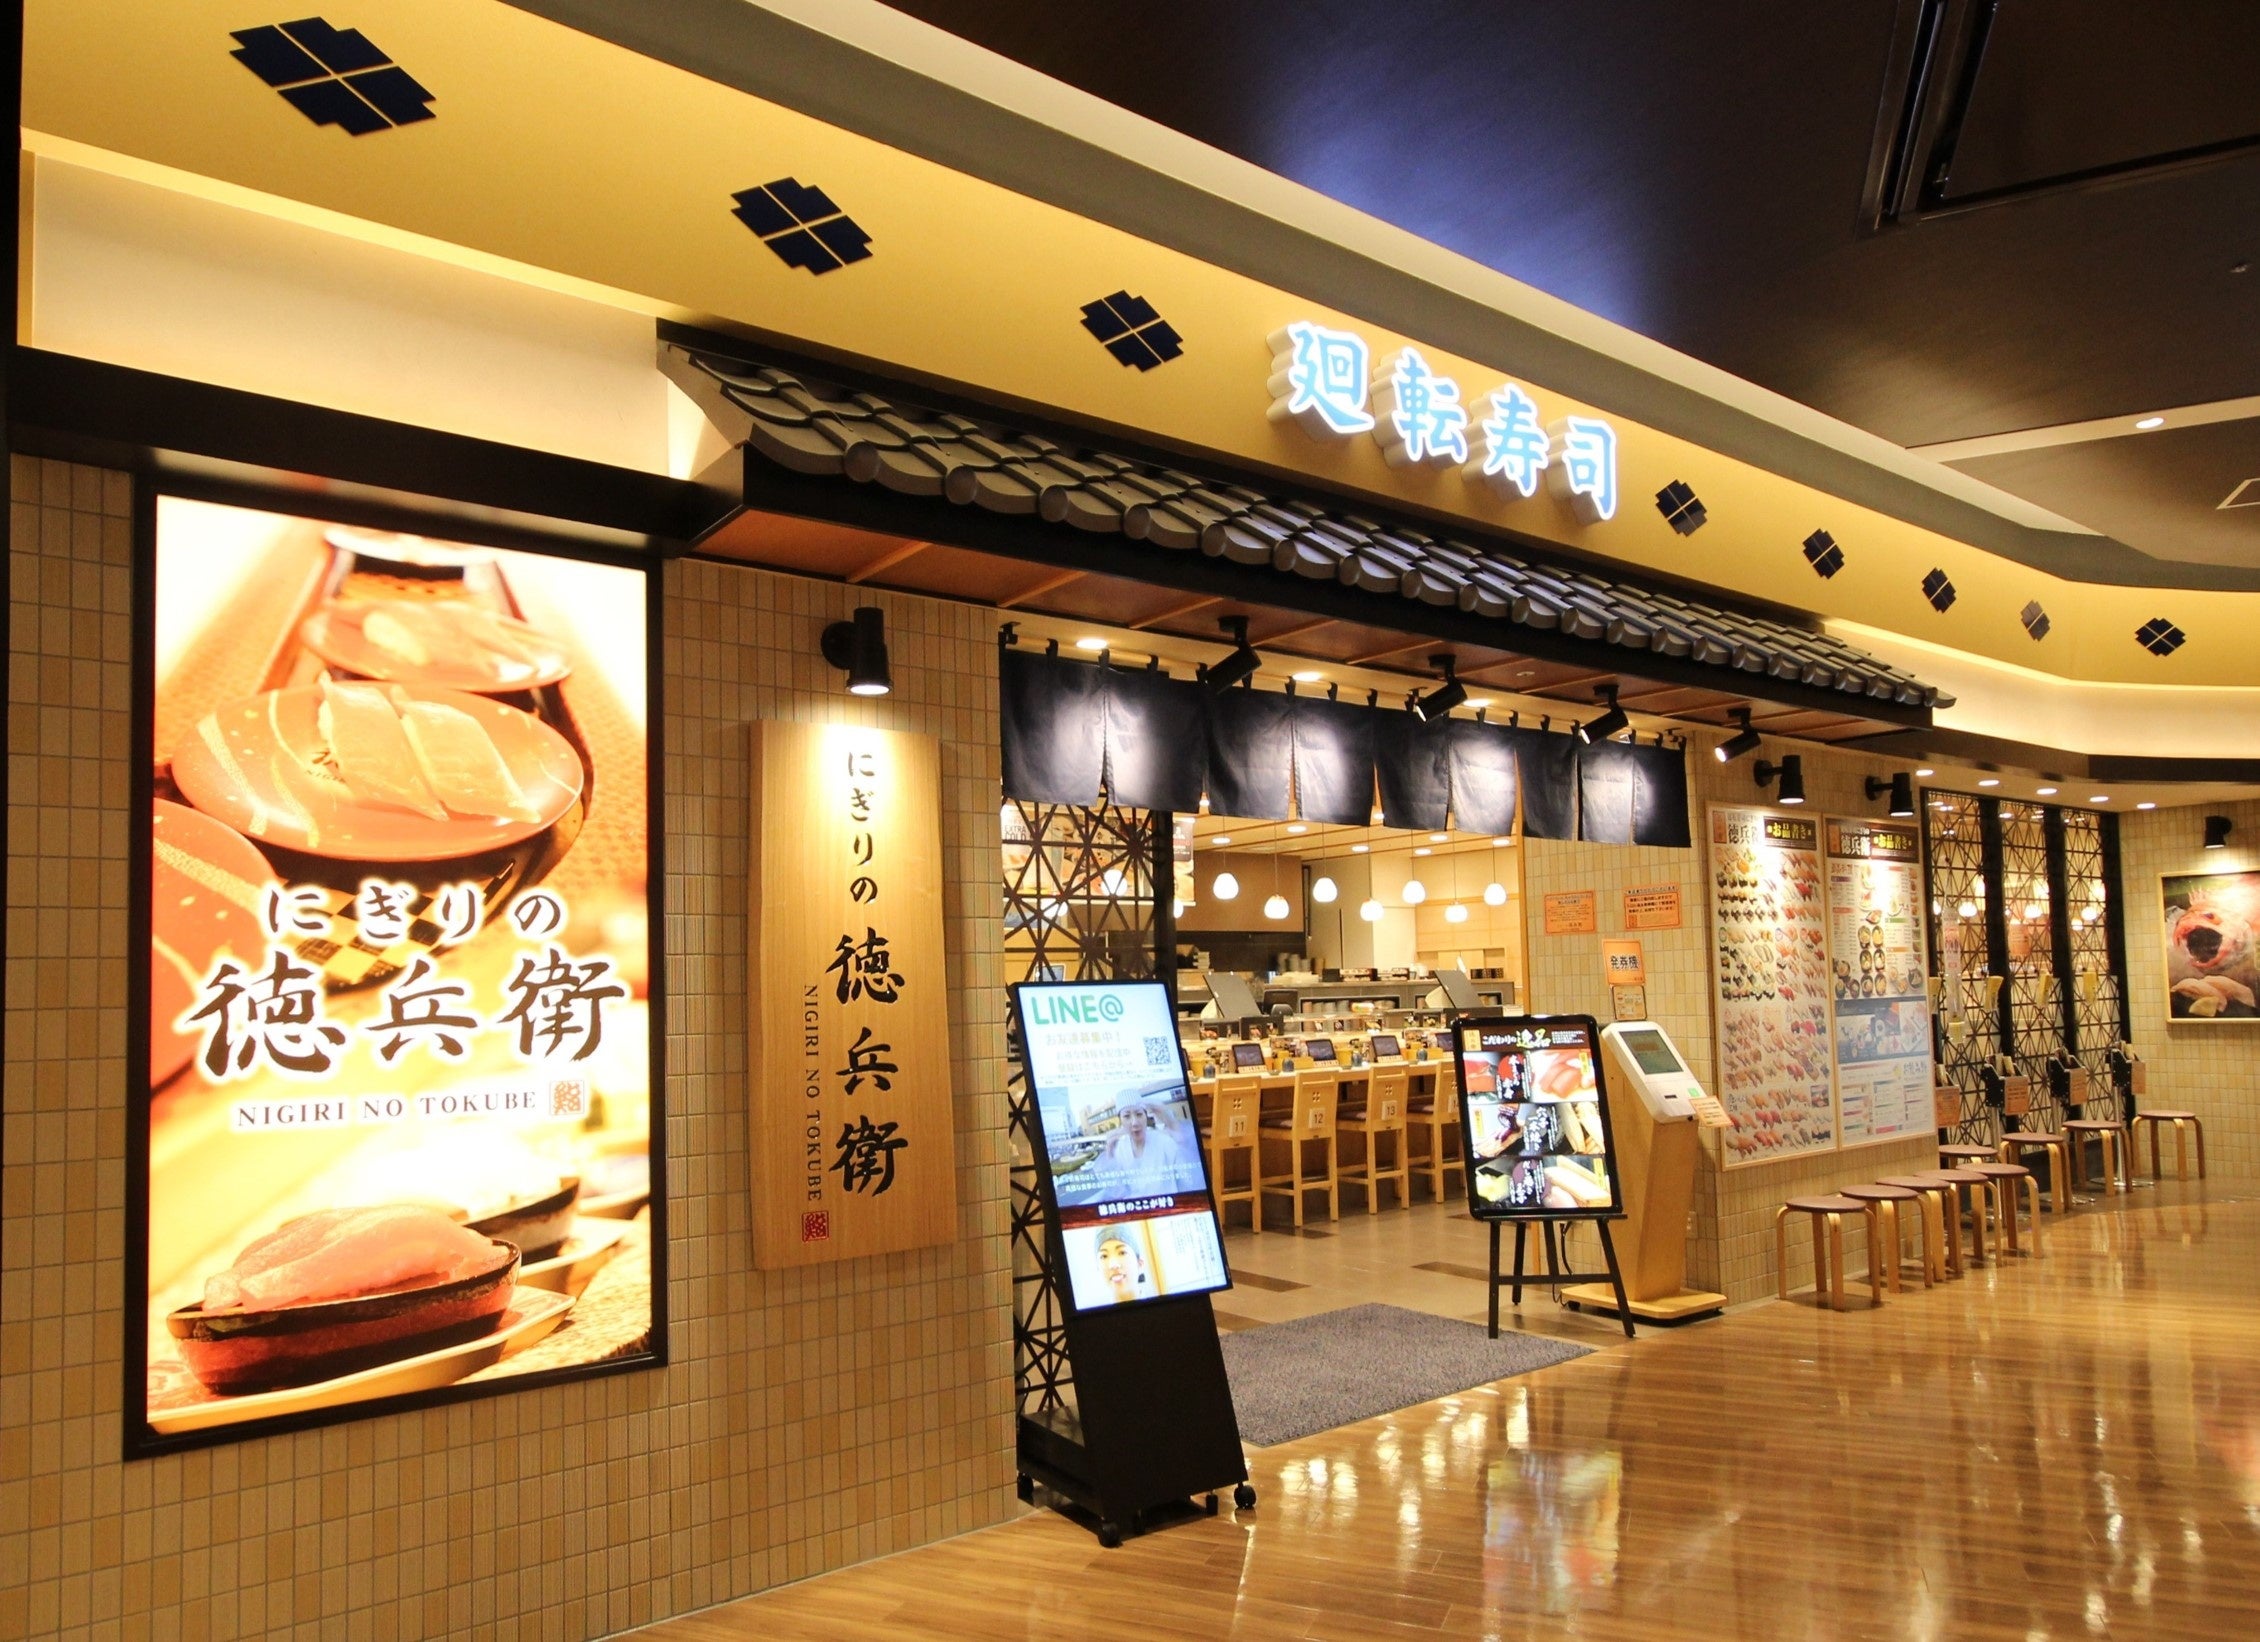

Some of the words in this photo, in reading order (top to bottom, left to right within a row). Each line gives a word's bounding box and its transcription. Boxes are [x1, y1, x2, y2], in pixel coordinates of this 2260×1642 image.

[1286, 320, 1617, 520] 廻転寿司
[268, 885, 562, 940] にぎりの
[1610, 954, 1640, 971] 発券機
[184, 947, 625, 1076] 徳兵衛
[804, 984, 820, 1058] NIGIRI
[1030, 993, 1125, 1026] LINE@
[806, 1069, 821, 1099] NO
[238, 1101, 346, 1127] NIGIRI
[363, 1099, 404, 1119] NO
[419, 1090, 537, 1116] TOKUBE
[1313, 1112, 1324, 1124] 12
[1386, 1105, 1396, 1117] 13
[1234, 1121, 1245, 1132] 11
[806, 1110, 823, 1202] TOKUBE
